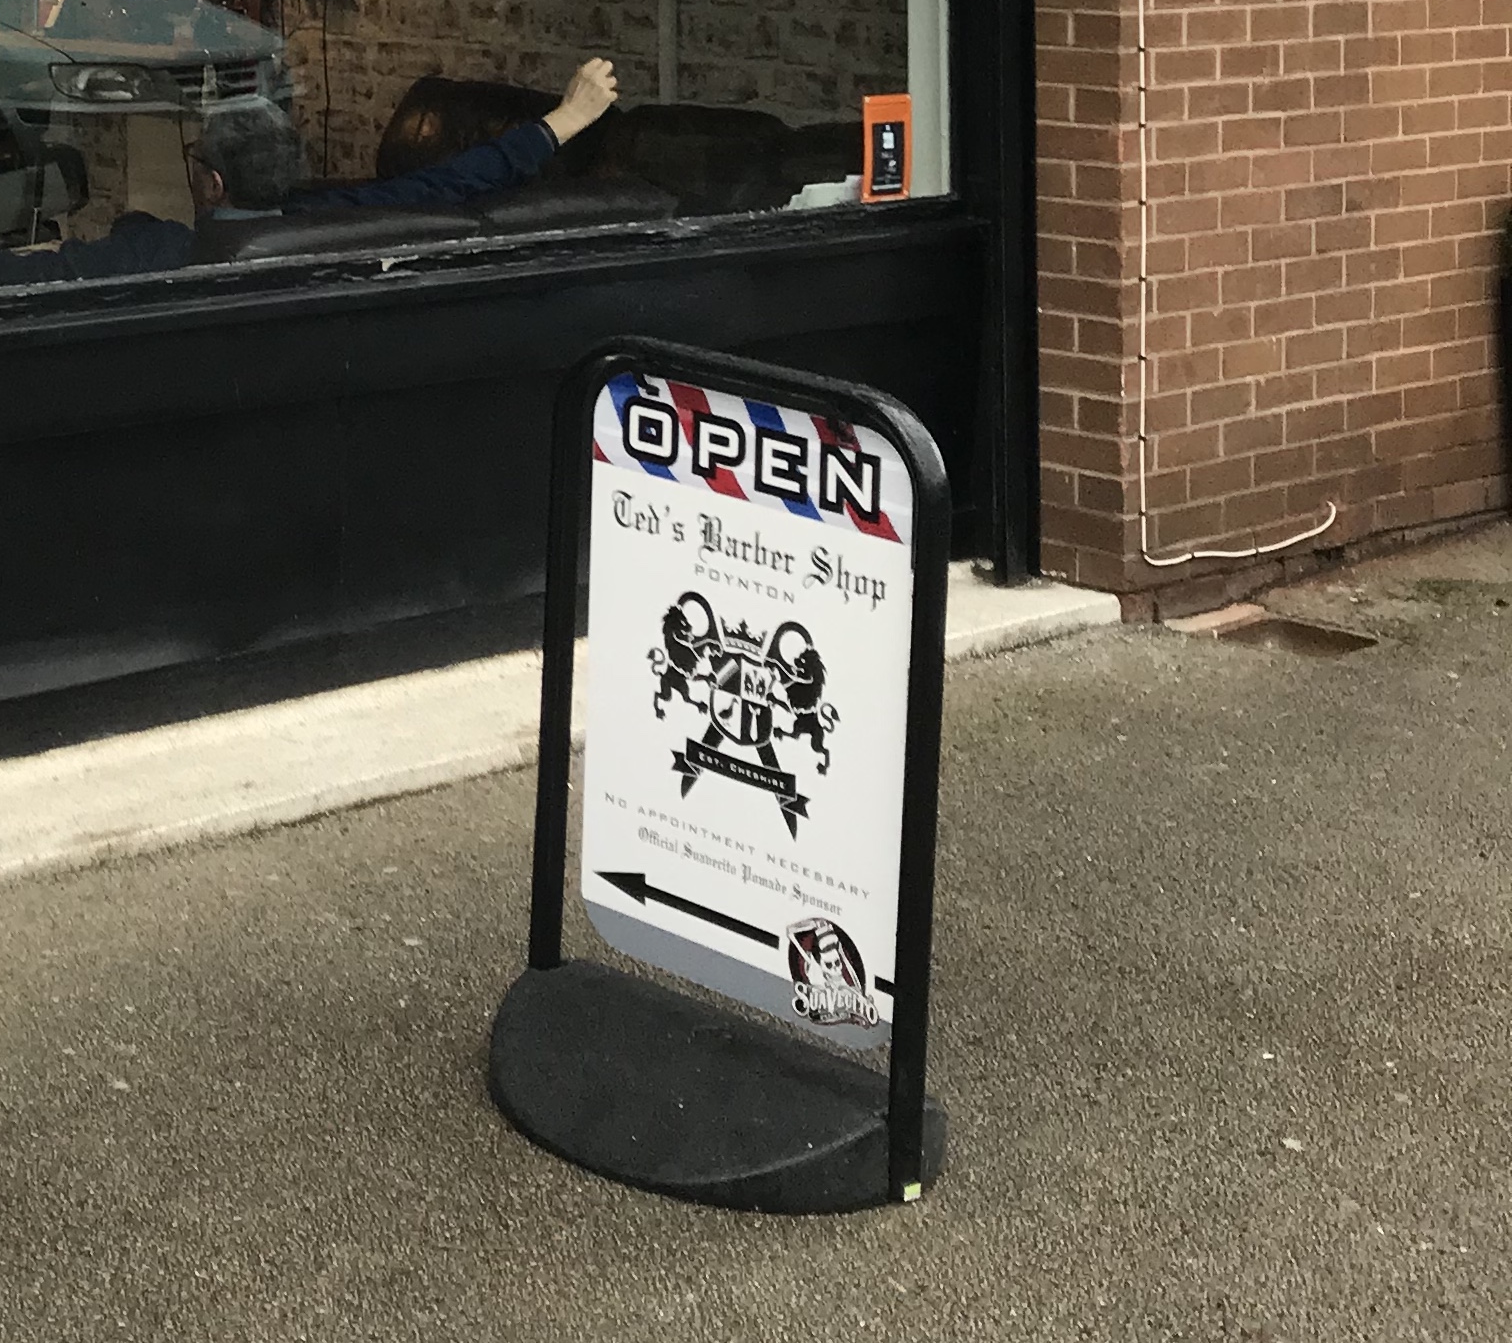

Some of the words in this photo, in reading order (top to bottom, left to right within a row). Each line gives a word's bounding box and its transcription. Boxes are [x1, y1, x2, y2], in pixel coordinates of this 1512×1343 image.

[623, 395, 881, 524] OPEN
[612, 489, 685, 543] Ted's
[697, 513, 795, 575] Barber
[802, 546, 887, 611] Shop
[694, 563, 795, 604] POYNTON
[604, 792, 628, 810] NO
[637, 805, 757, 856] APPOINTMENT
[766, 853, 871, 900] NECESSARY
[638, 825, 679, 855] Official
[681, 841, 738, 876] Suavecito
[741, 862, 788, 896] Pomade
[791, 883, 843, 916] Sponsor
